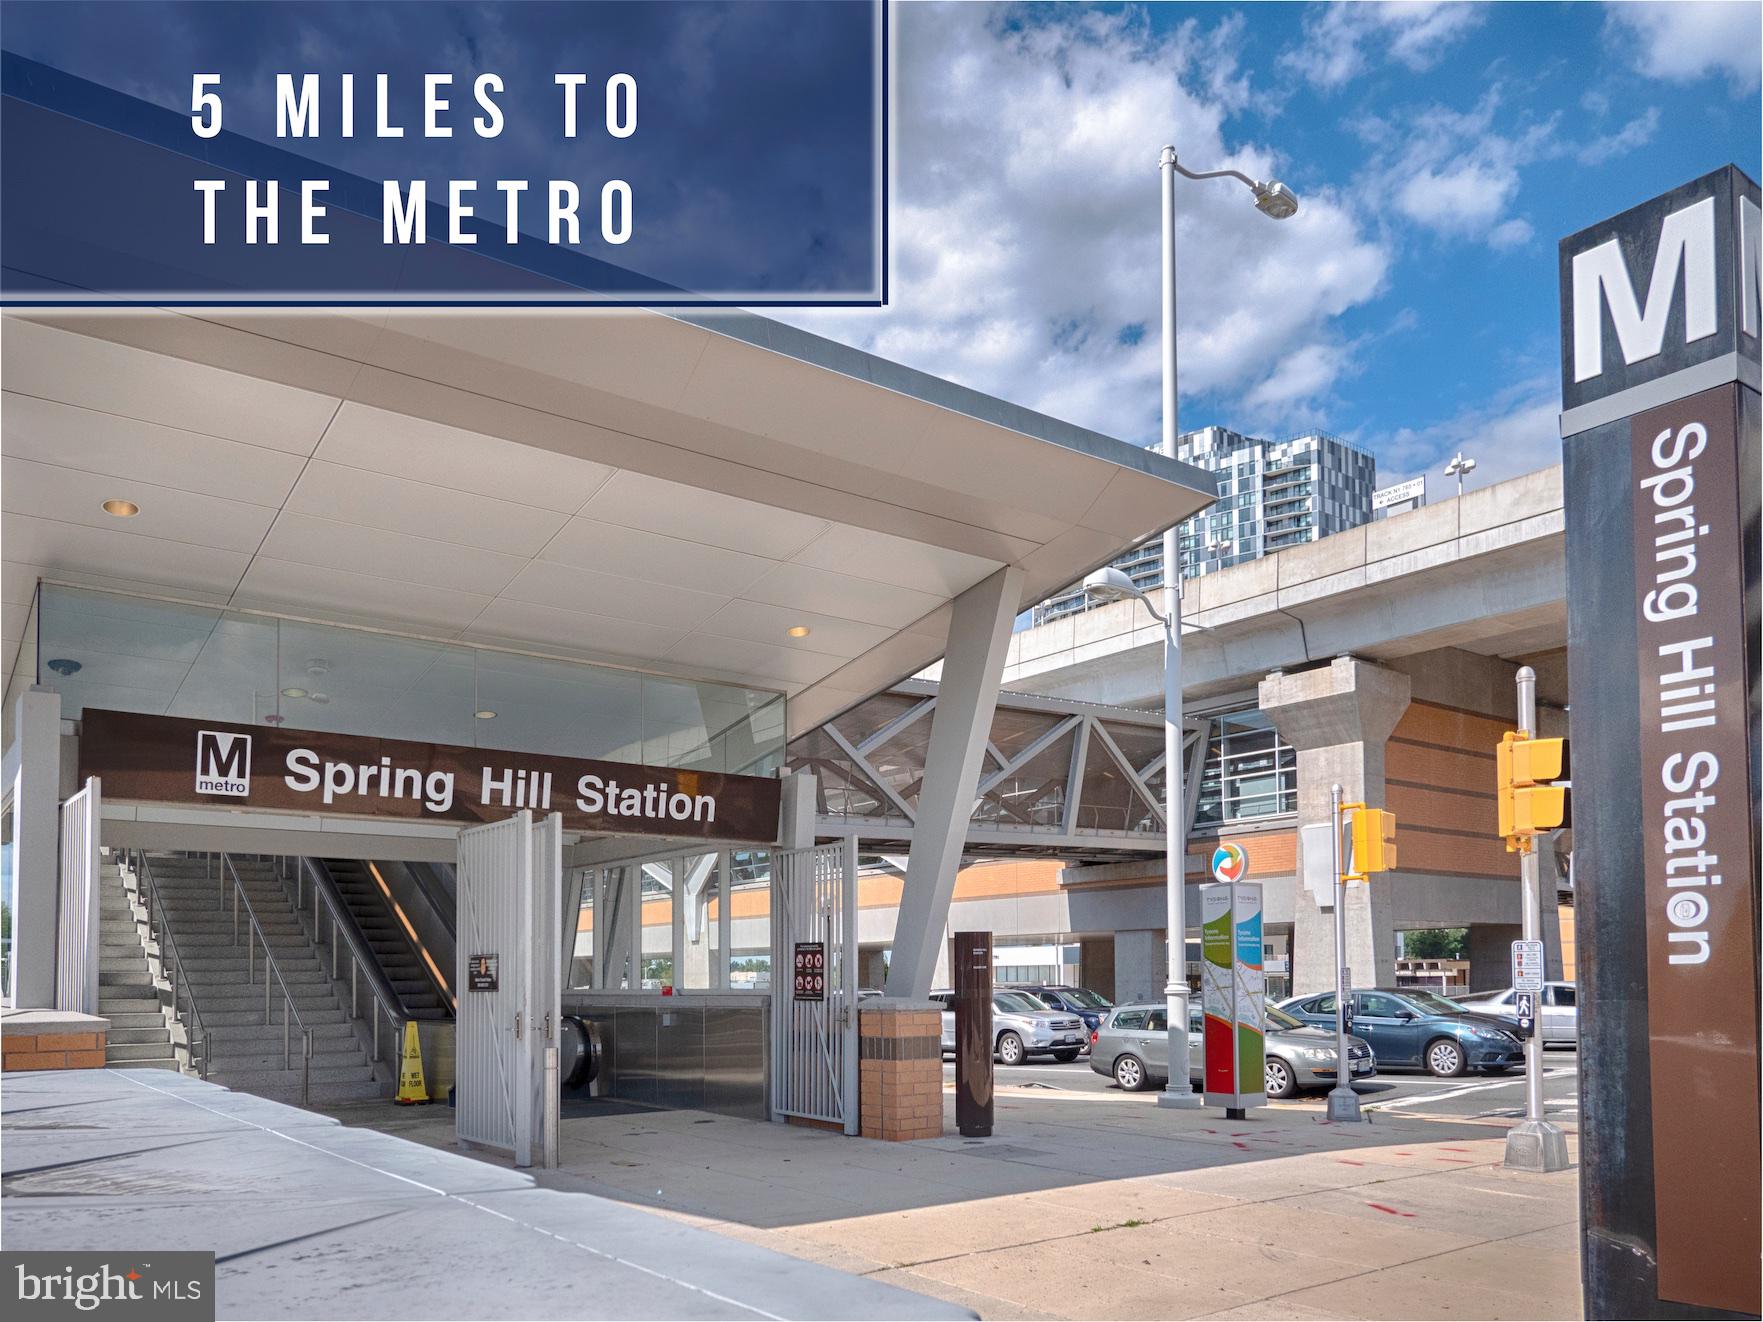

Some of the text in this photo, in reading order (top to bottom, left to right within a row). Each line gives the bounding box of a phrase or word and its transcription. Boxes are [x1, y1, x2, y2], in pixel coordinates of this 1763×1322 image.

[1573, 196, 1717, 383] M
[1373, 491, 1392, 500] TRACK
[1387, 492, 1410, 503] ACCESS
[1640, 422, 1722, 964] Spring Hill Station
[200, 734, 248, 779] M
[199, 780, 246, 793] metro
[285, 748, 716, 822] Spring Hill Station
